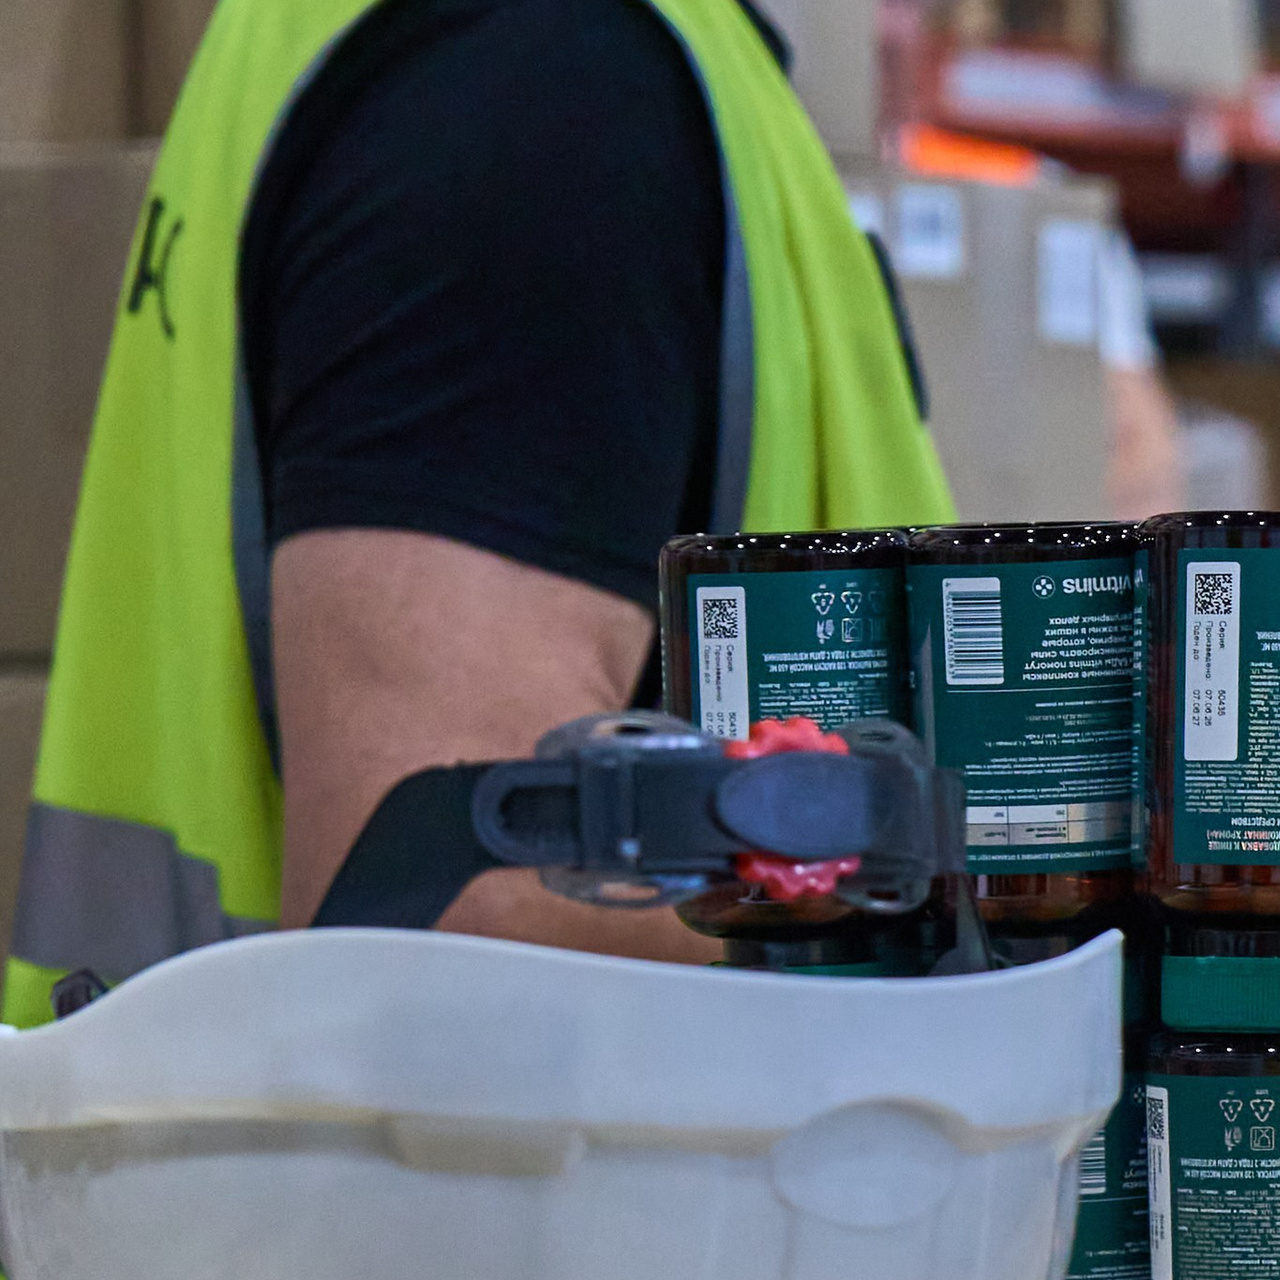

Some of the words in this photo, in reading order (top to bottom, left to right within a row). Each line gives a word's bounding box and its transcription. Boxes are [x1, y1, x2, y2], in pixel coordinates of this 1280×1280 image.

[1062, 574, 1132, 597] vitmins
[1048, 616, 1080, 625] делах
[1044, 628, 1078, 637] наших
[1042, 638, 1085, 648] которые
[1031, 650, 1057, 658] силы
[1024, 659, 1066, 670] помогут
[1069, 660, 1103, 669] vitmins
[1022, 672, 1079, 681] комплексы
[1231, 817, 1275, 826] СРЕДСТВОМ
[1208, 841, 1232, 850] ПИЩЕ
[1234, 842, 1240, 850] К
[1241, 841, 1280, 851] ДОБАВКА
